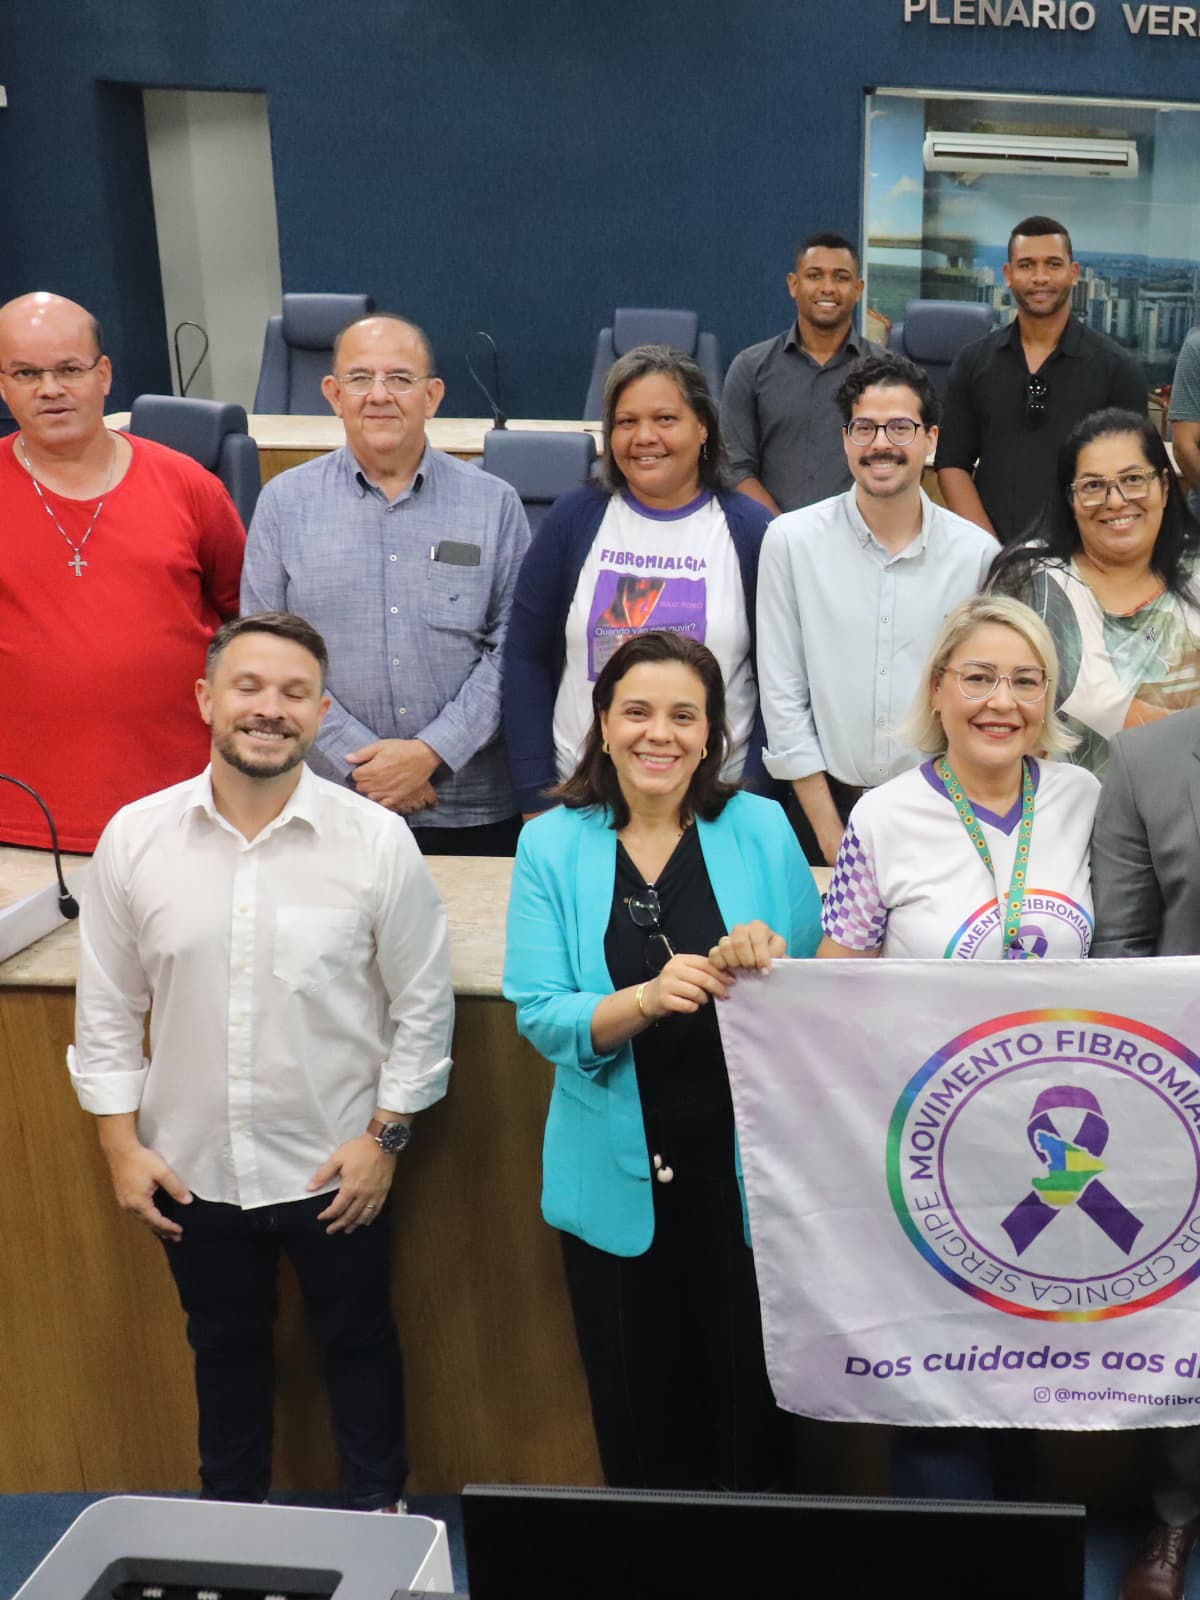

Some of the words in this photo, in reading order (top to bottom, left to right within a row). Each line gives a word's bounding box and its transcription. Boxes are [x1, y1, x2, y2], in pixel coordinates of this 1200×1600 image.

[600, 548, 706, 571] FIBROMIALGIA
[909, 1033, 1043, 1180] MOVIMENTO
[914, 1191, 1022, 1293] SERGIPE
[1031, 1255, 1176, 1306] CRÔNICA
[844, 1355, 912, 1379] Dos
[922, 1345, 1090, 1374] cuidados
[1101, 1348, 1164, 1374] aos
